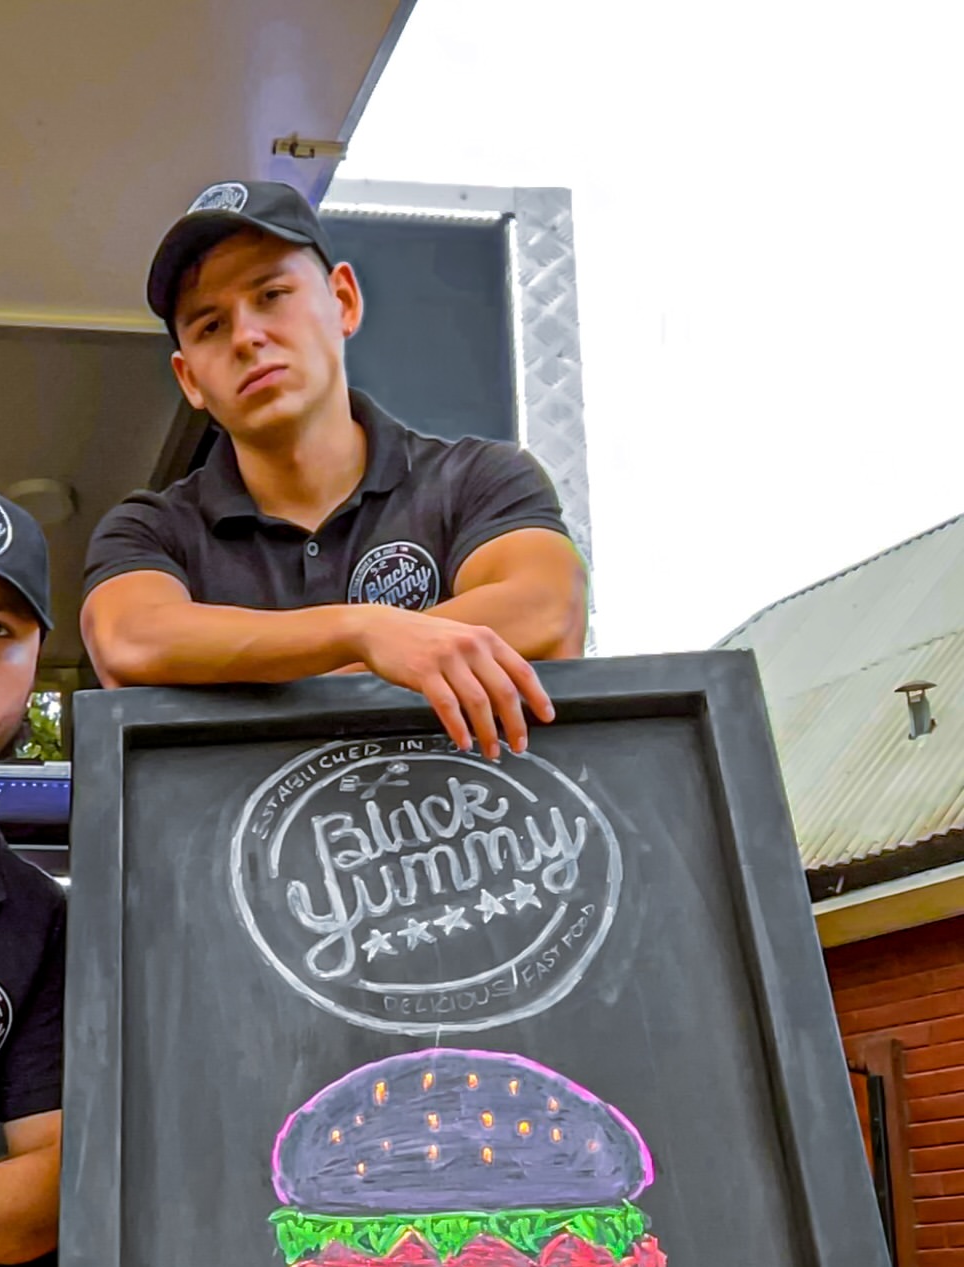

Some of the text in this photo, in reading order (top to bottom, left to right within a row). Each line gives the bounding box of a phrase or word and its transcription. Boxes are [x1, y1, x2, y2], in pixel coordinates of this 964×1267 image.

[364, 557, 415, 601] Black
[370, 566, 432, 606] ummy
[399, 739, 424, 752] IN
